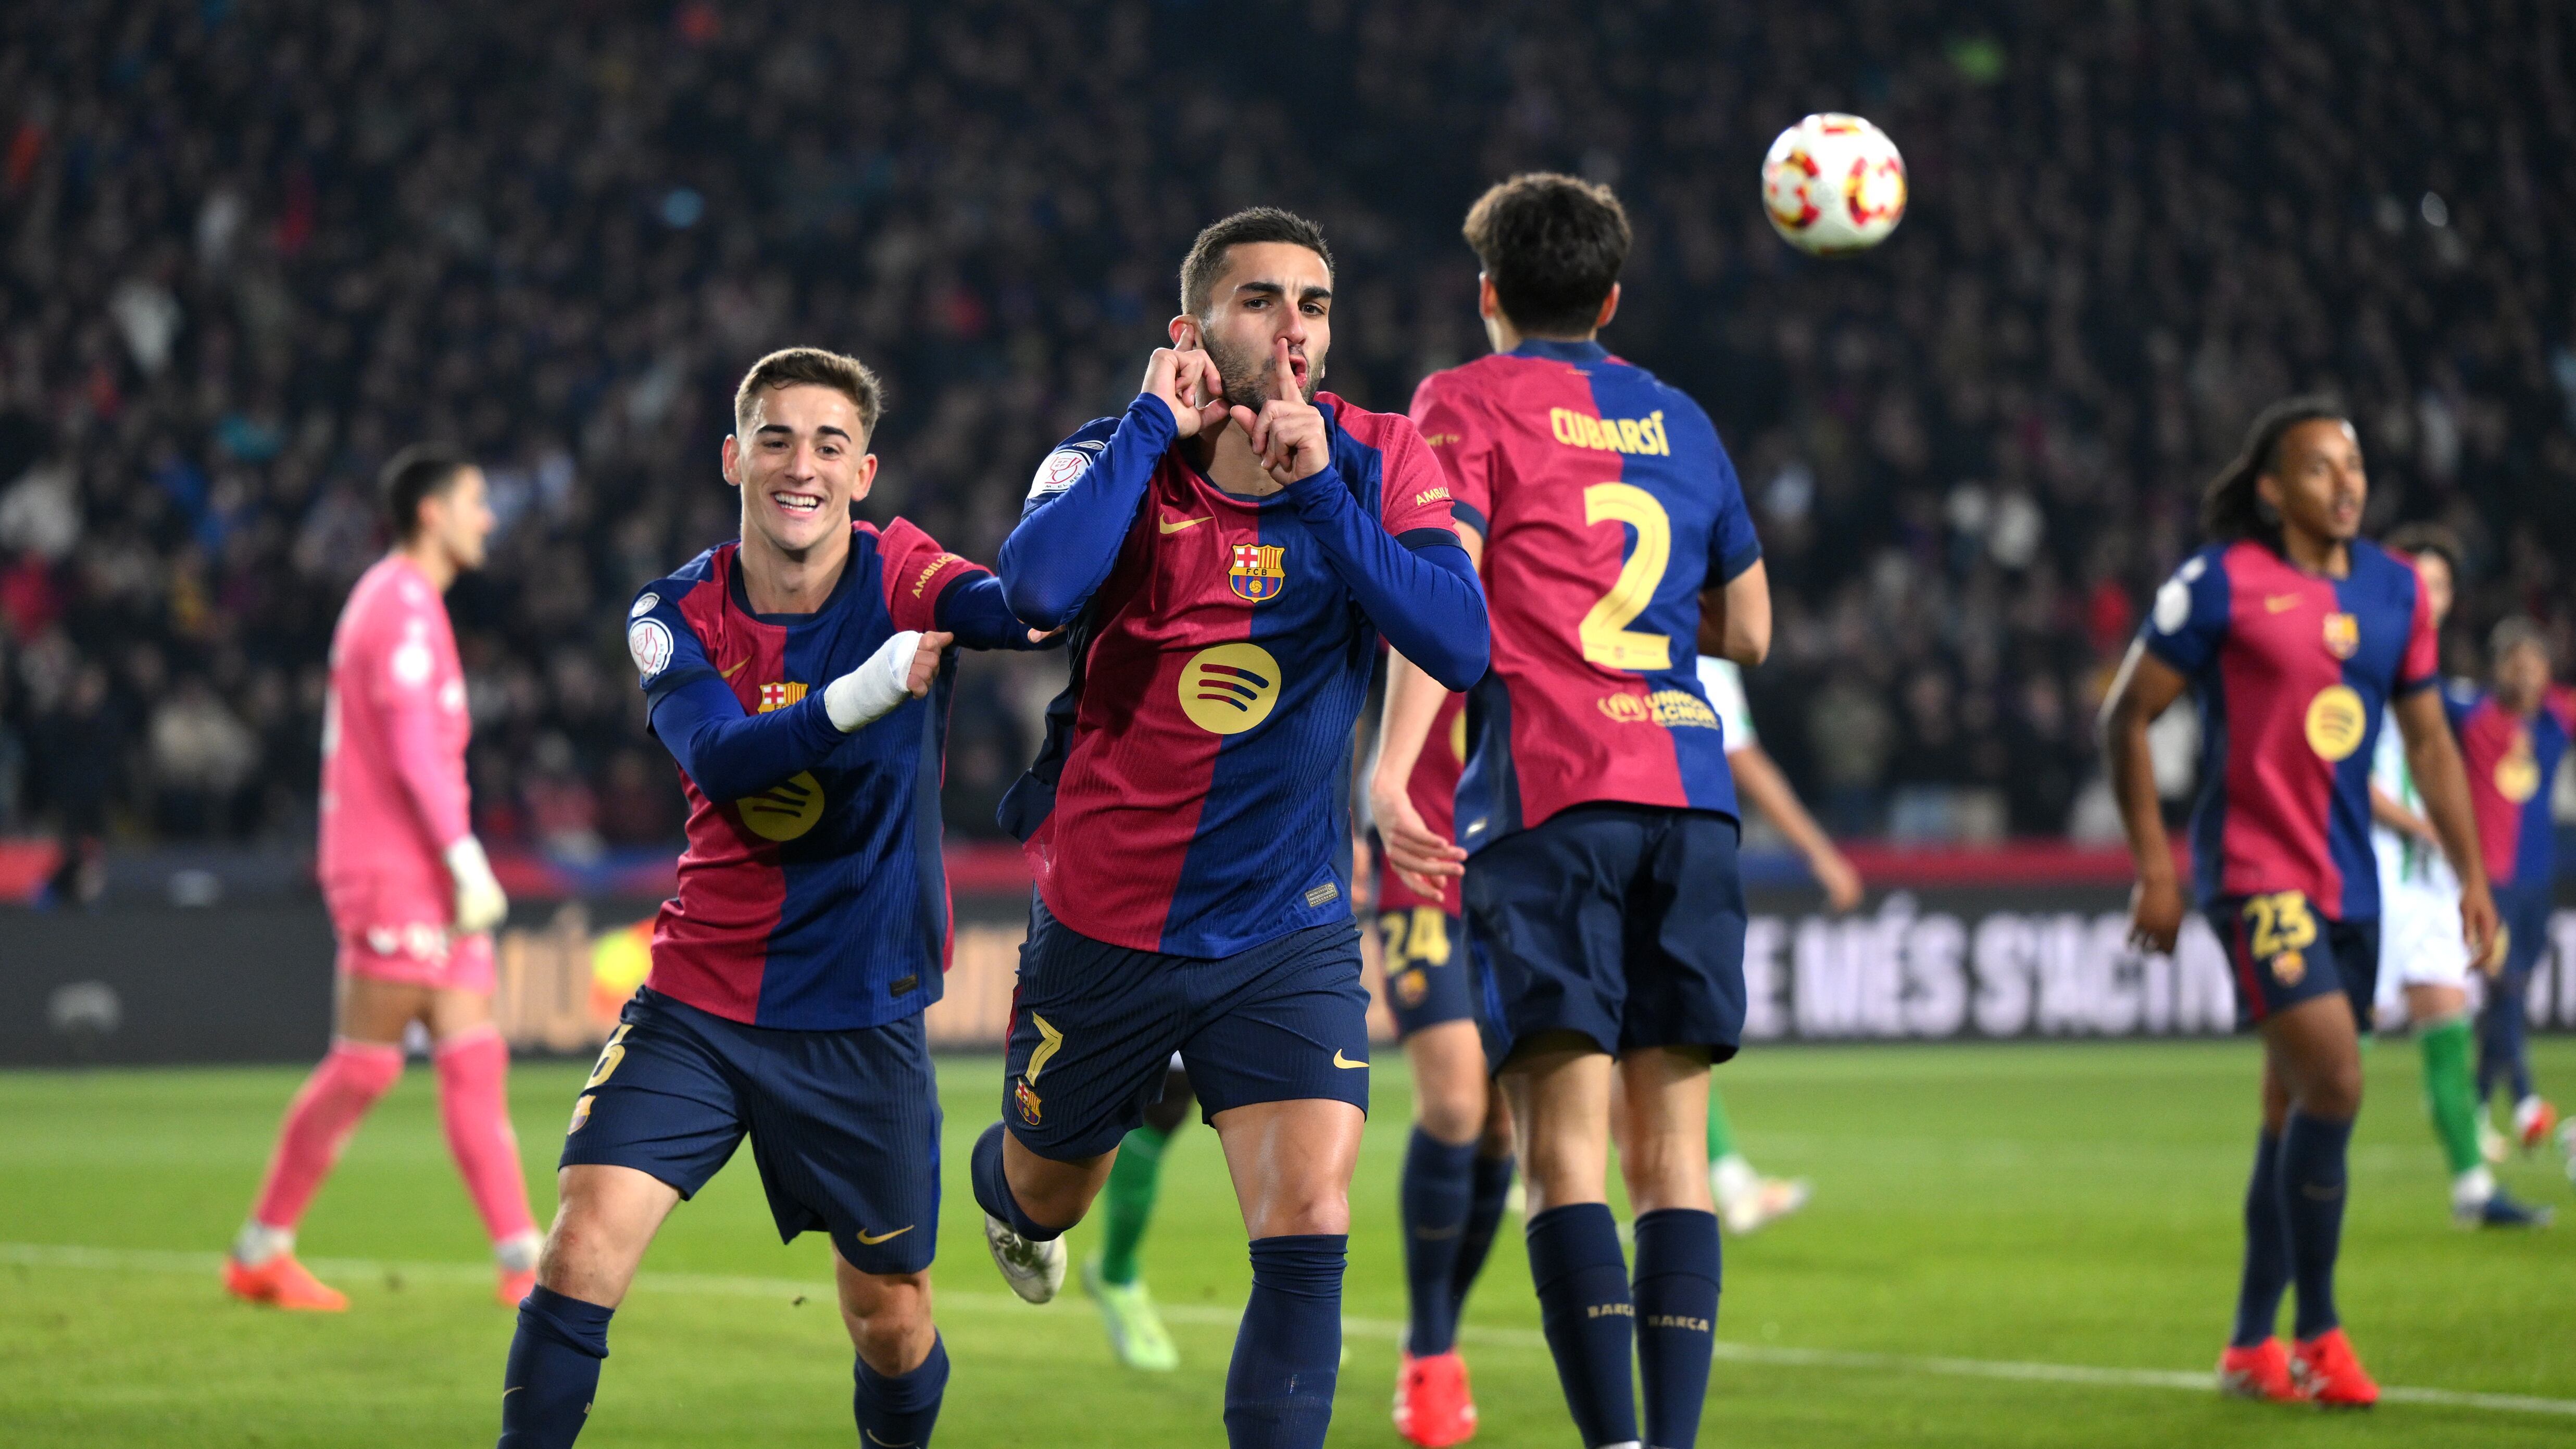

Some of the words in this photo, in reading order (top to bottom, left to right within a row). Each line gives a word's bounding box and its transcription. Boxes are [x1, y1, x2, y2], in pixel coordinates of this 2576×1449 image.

[1550, 407, 1670, 456] CUBARSÍ
[1579, 482, 1672, 670] 2
[1381, 905, 1451, 975] 24
[2242, 890, 2317, 960] 23
[584, 1024, 634, 1089] 6
[1025, 1010, 1064, 1088] 7
